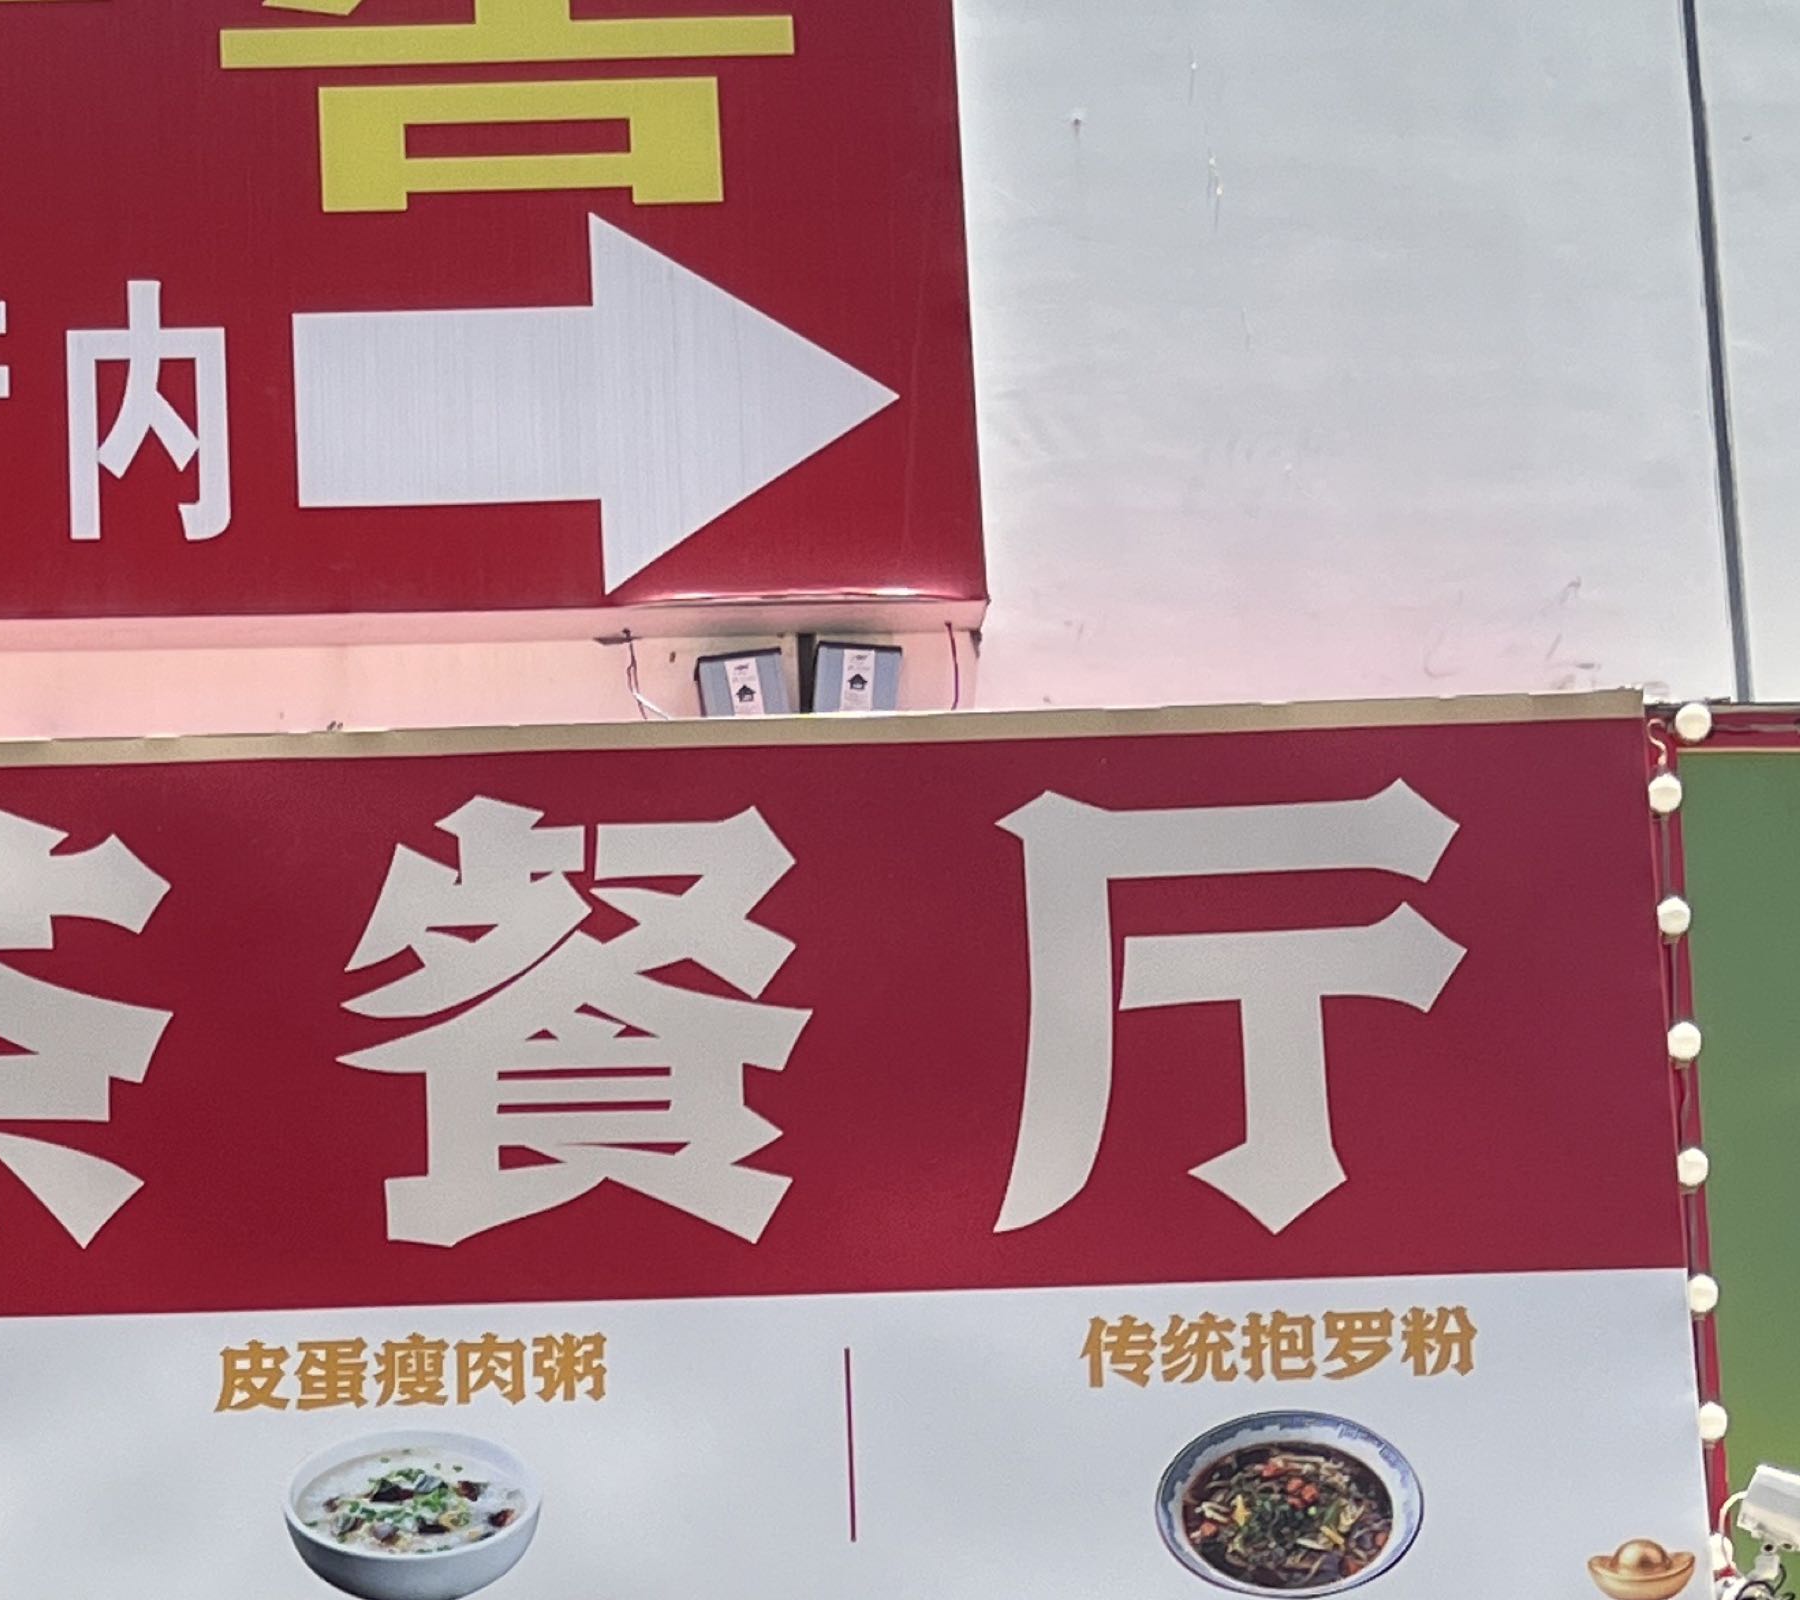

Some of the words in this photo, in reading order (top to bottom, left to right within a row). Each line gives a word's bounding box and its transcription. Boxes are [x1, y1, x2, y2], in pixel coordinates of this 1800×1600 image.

[213, 1332, 609, 1416] 皮蛋瘦肉粥
[1080, 1305, 1479, 1389] 传统抱罗粉
